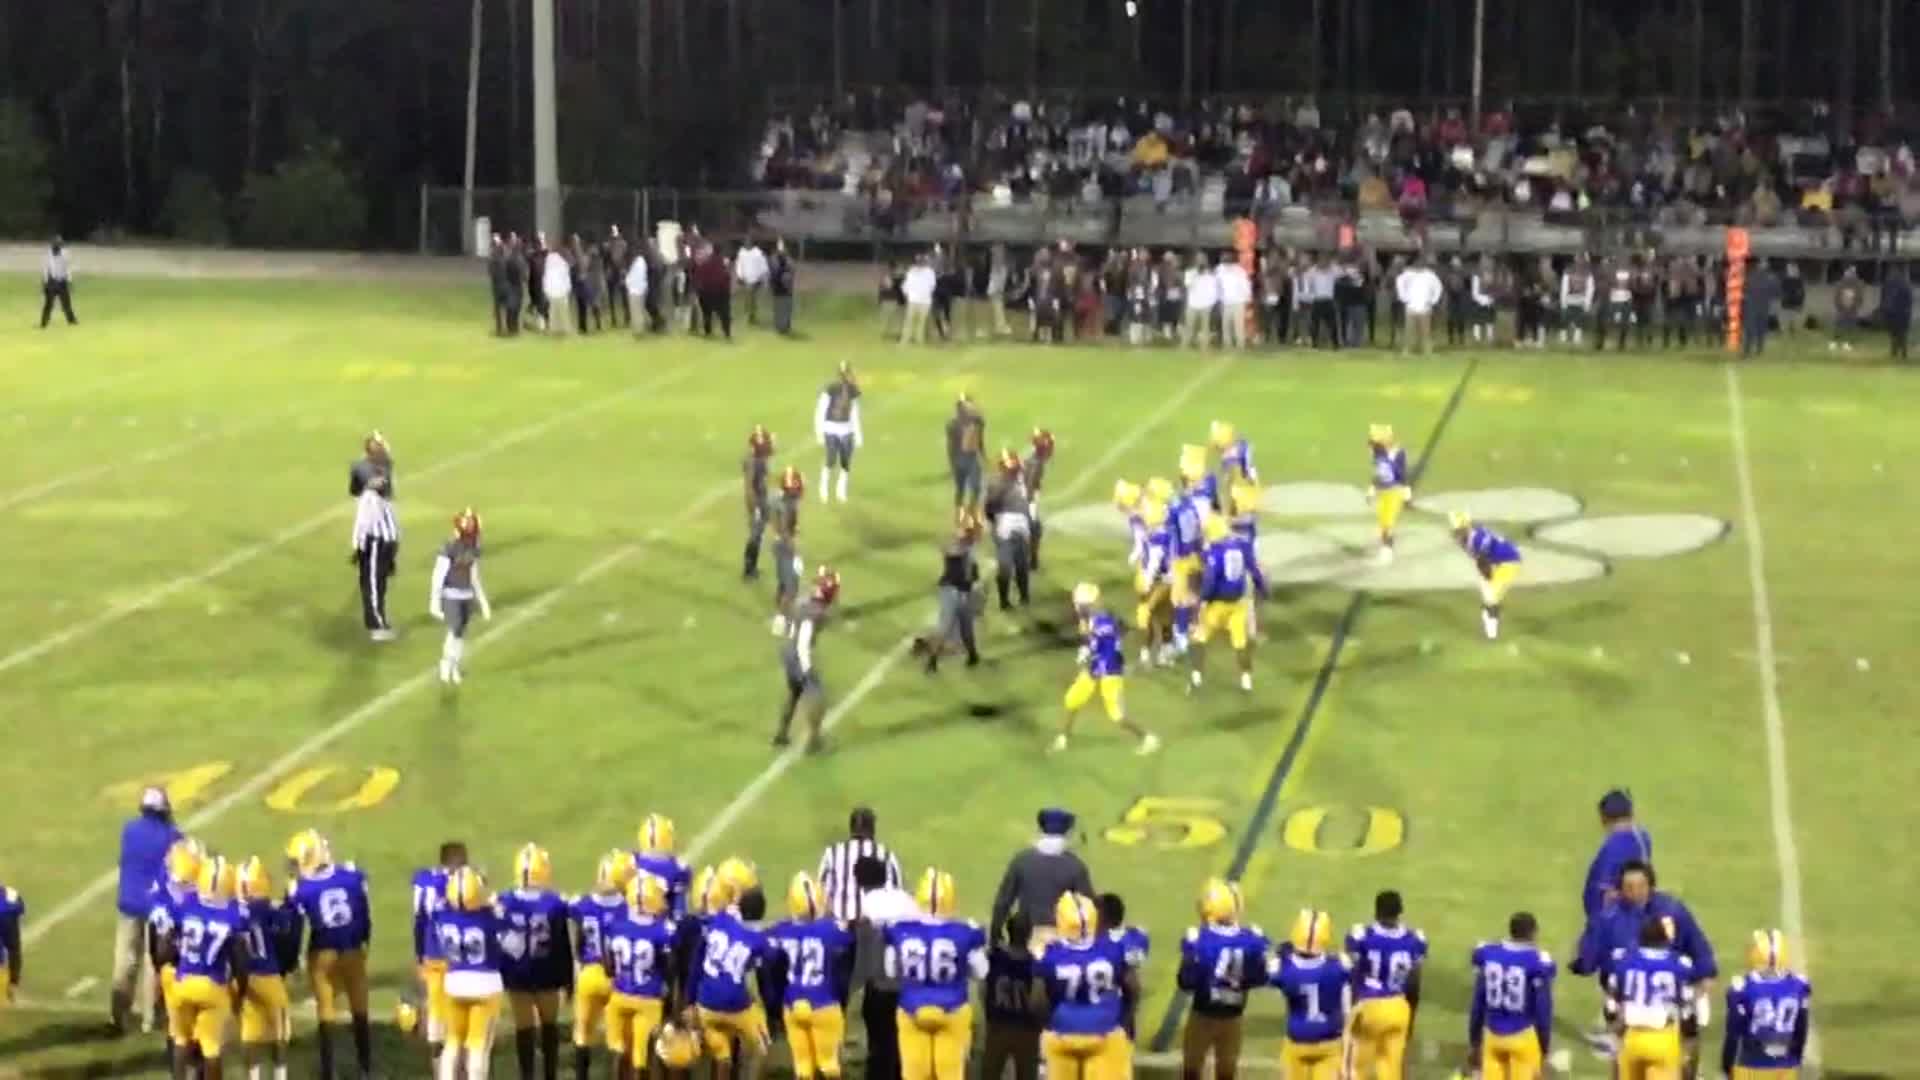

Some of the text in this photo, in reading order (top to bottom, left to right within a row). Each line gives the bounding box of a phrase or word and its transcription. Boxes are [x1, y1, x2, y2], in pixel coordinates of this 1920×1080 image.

[1104, 797, 1404, 854] 50
[319, 888, 352, 928] 6
[180, 917, 231, 966] 27
[1299, 984, 1325, 1022] 1
